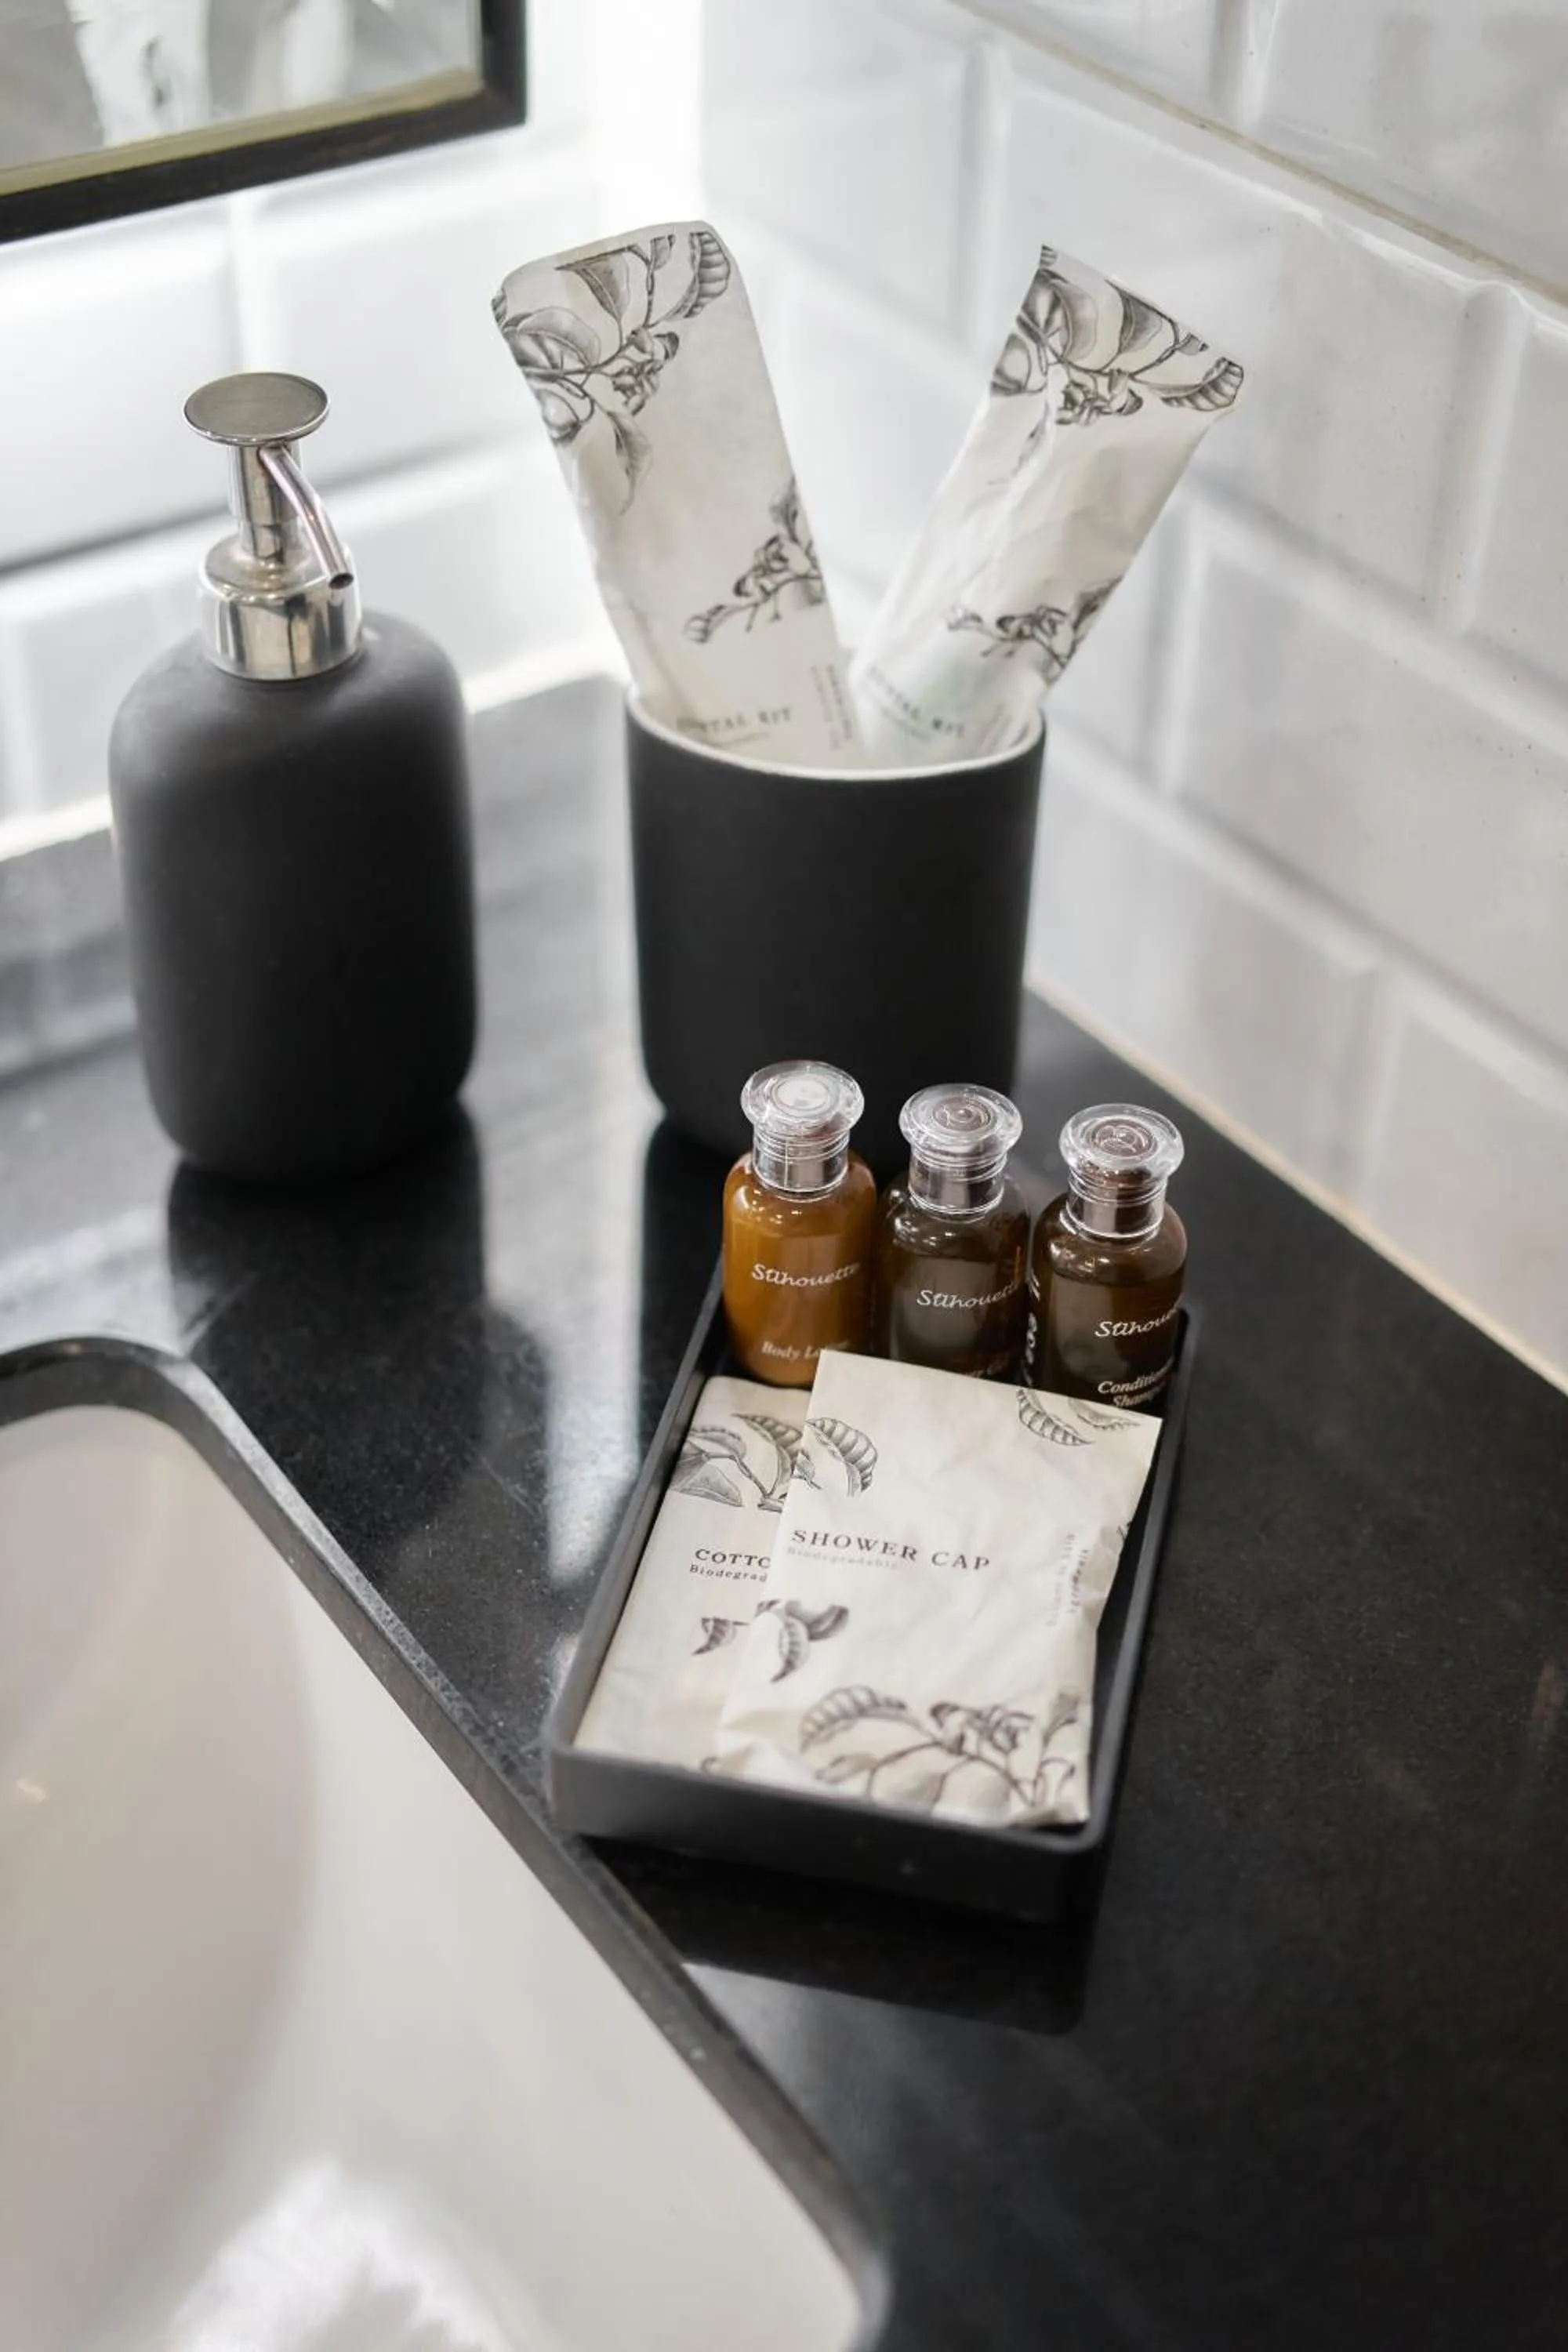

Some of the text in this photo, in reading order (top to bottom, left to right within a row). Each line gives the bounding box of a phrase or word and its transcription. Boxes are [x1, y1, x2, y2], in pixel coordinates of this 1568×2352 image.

[762, 1340, 800, 1363] Body
[695, 1548, 771, 1570] COTTO
[791, 1530, 990, 1571] SHOWER CAP
[689, 1563, 768, 1583] Biodegrad
